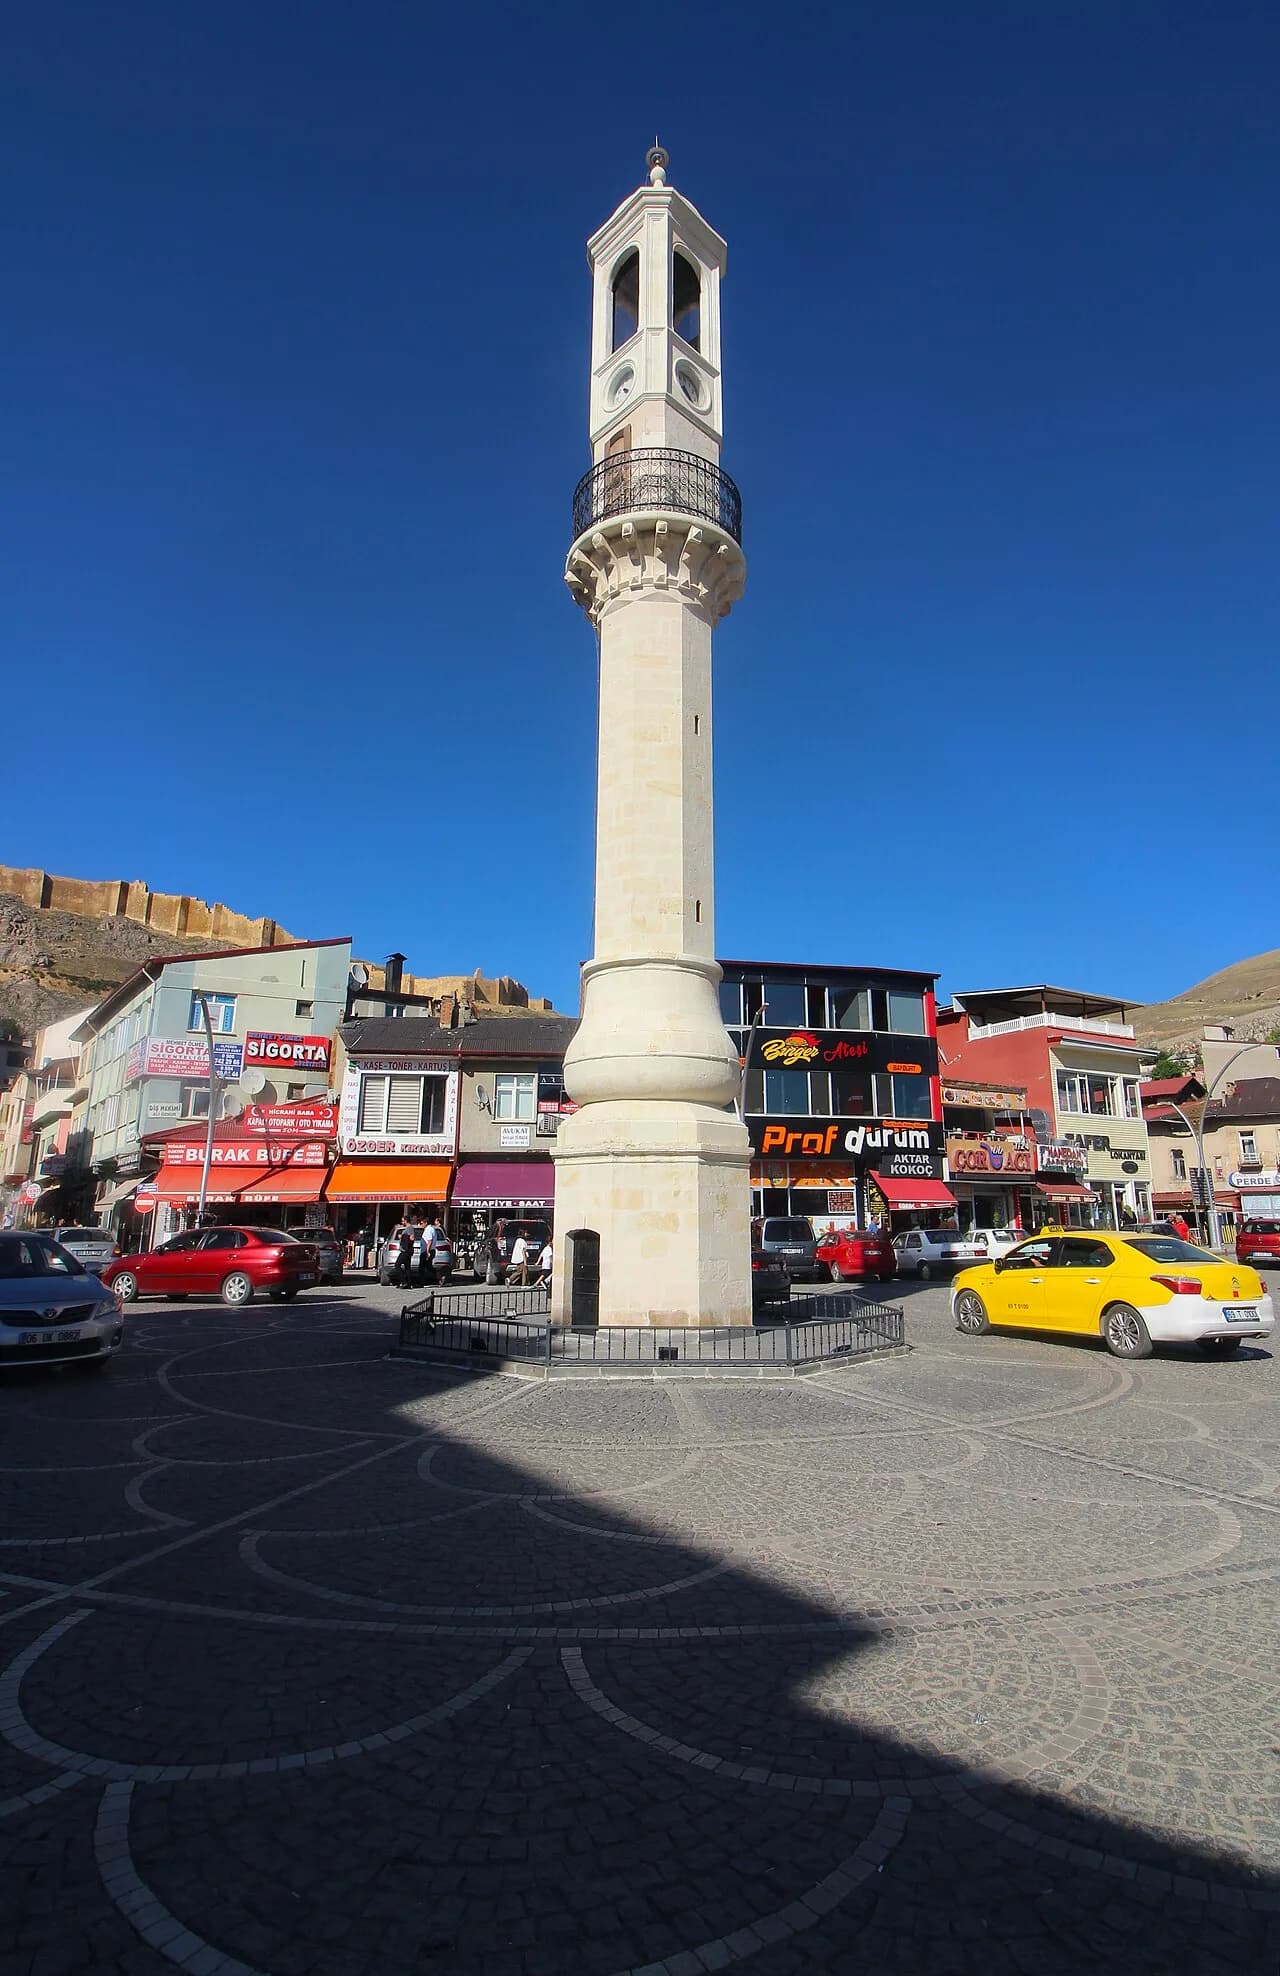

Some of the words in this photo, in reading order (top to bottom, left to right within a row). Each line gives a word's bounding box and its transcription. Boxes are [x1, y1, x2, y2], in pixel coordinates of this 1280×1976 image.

[151, 1042, 210, 1055] SİGORTA
[247, 1039, 327, 1061] SİGORTA
[761, 1039, 820, 1066] Burger
[364, 1061, 383, 1070] KAŞE
[388, 1061, 413, 1070] TONER
[418, 1062, 448, 1072] KARTUŞ
[268, 1118, 295, 1127] OTOPARK
[299, 1119, 311, 1127] OTO
[312, 1119, 334, 1128] YIKAMA
[761, 1125, 839, 1155] Prof
[844, 1125, 930, 1154] dürüm
[185, 1148, 250, 1162] BURAK
[255, 1146, 305, 1162] BÜFE
[894, 1154, 930, 1164] AKTAR
[890, 1164, 934, 1177] KOKOÇ
[459, 1198, 513, 1207] TUHAFİYE
